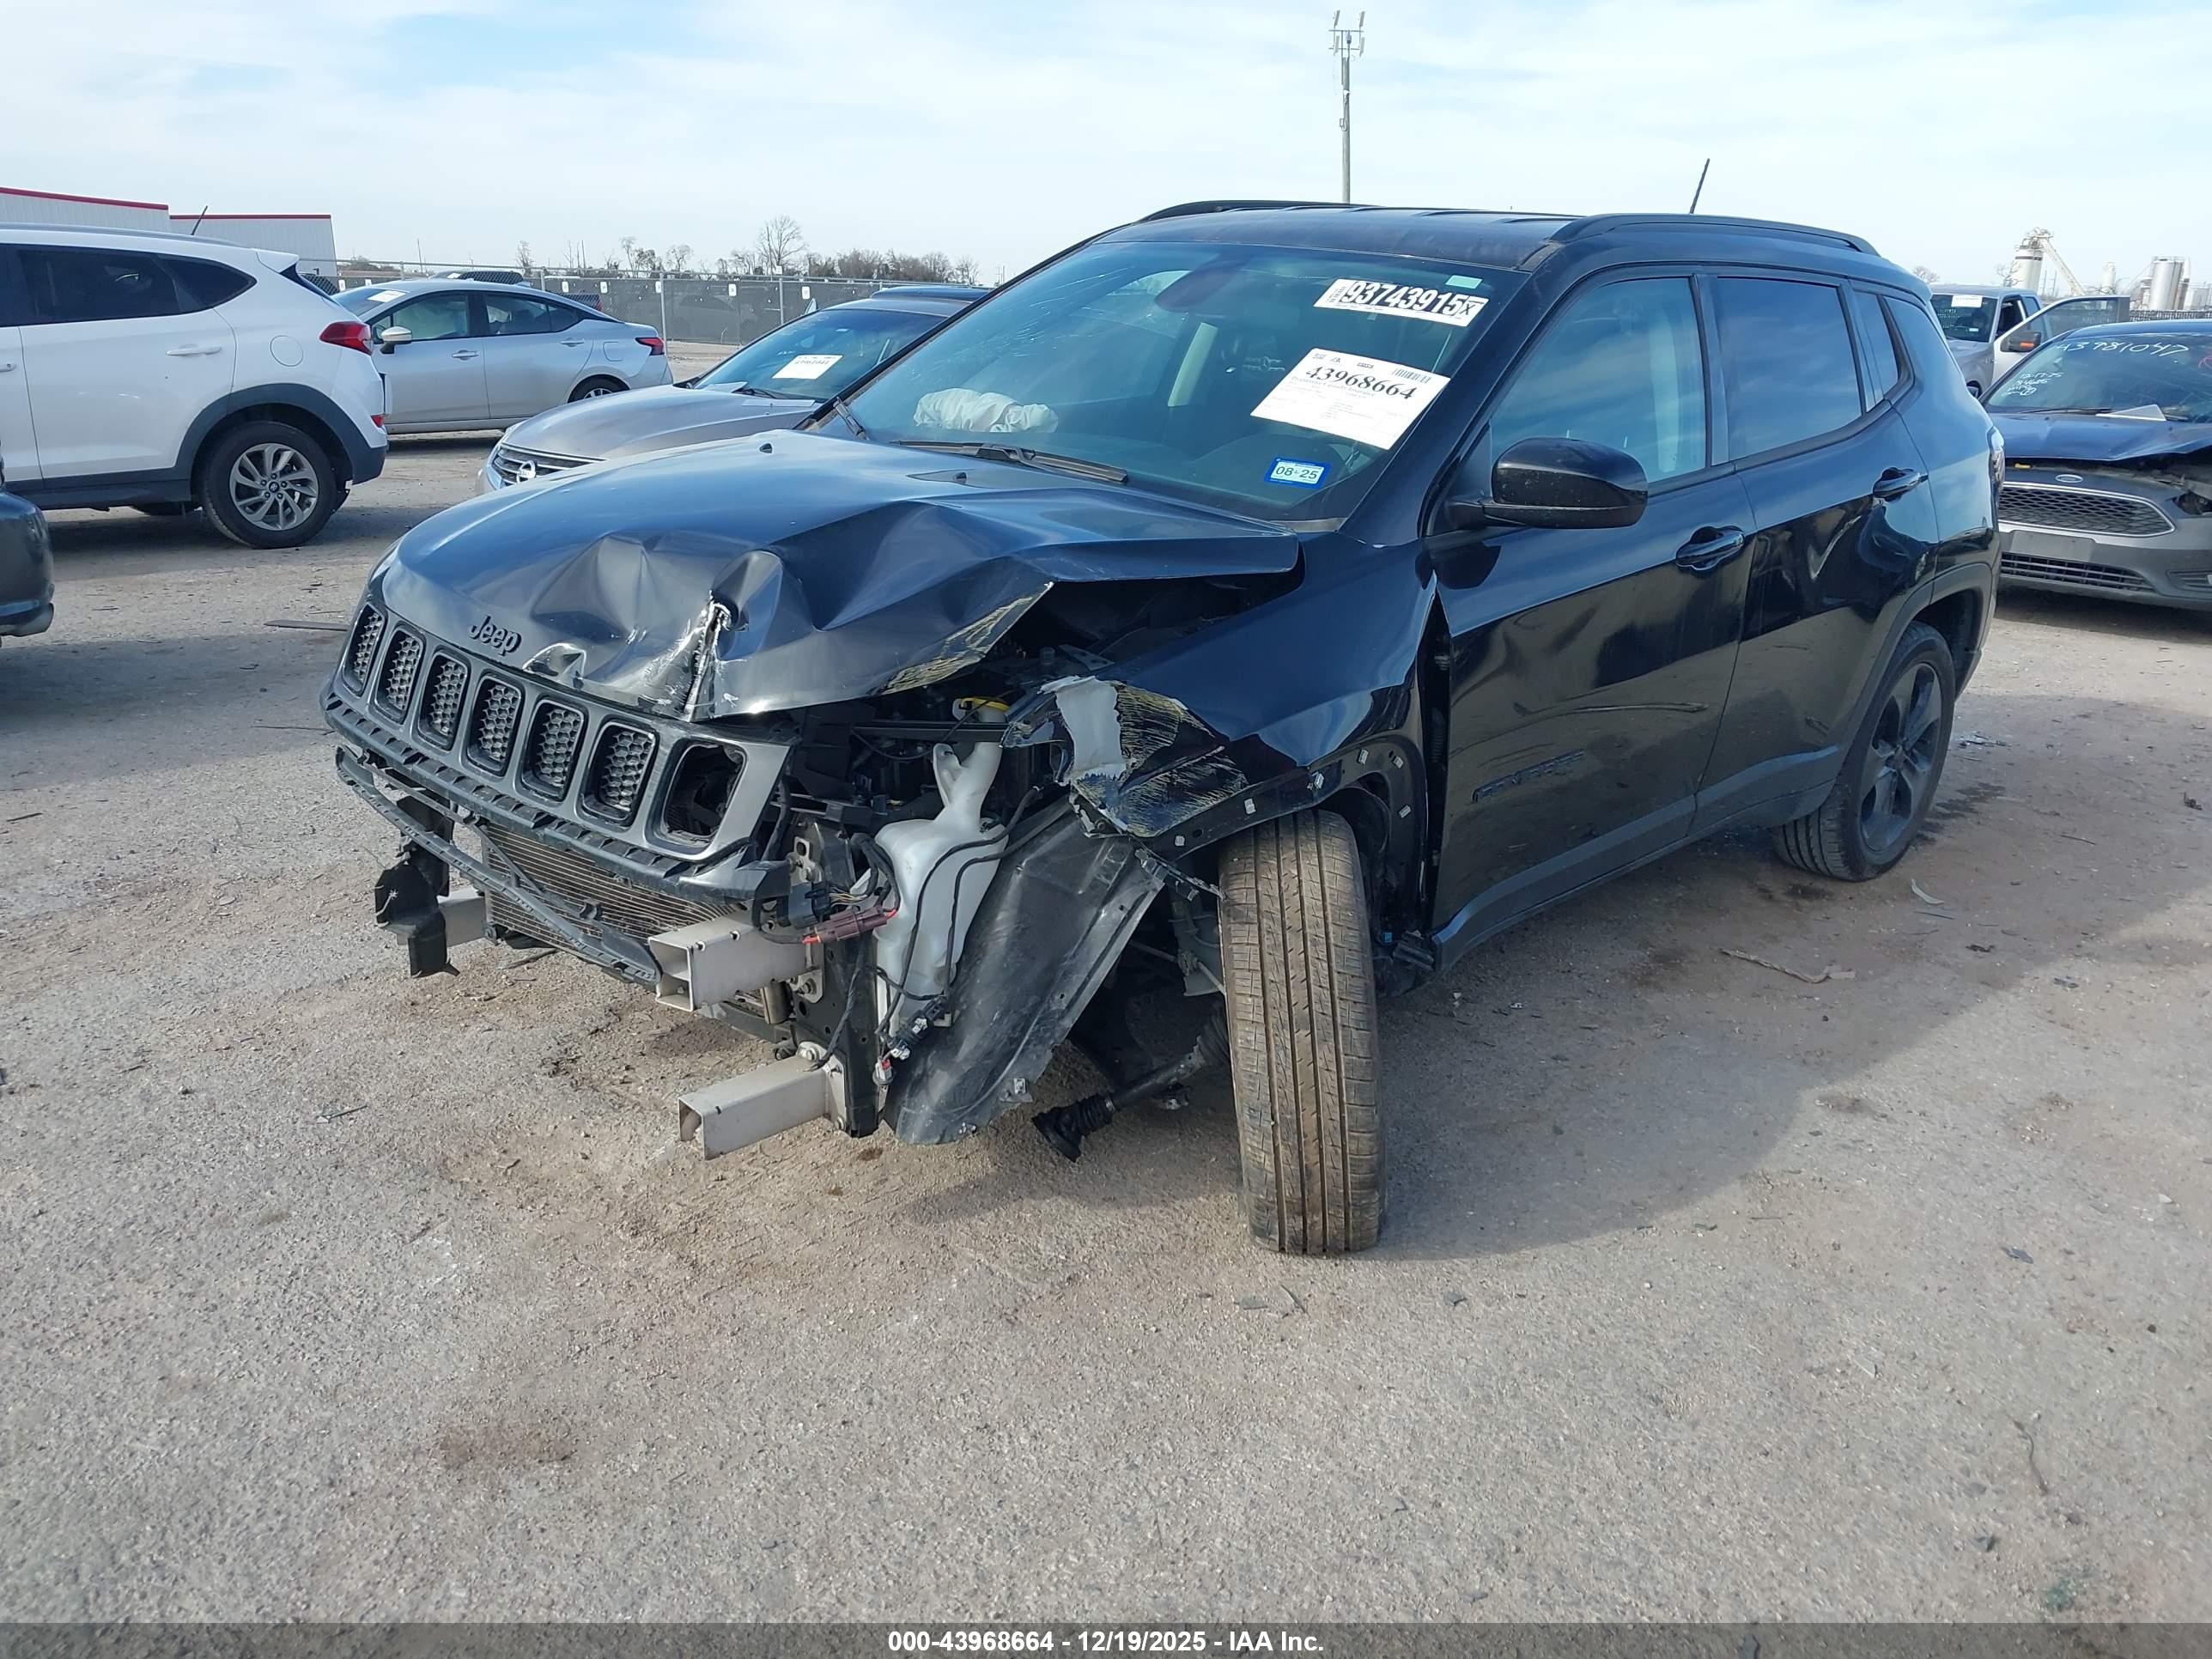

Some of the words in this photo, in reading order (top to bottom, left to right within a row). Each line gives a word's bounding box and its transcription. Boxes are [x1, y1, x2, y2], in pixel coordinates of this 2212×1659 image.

[1342, 281, 1469, 316] 93743915
[1305, 366, 1419, 400] 43968664
[1275, 466, 1294, 477] 08
[1298, 469, 1320, 479] 25
[468, 615, 523, 657] Jeep
